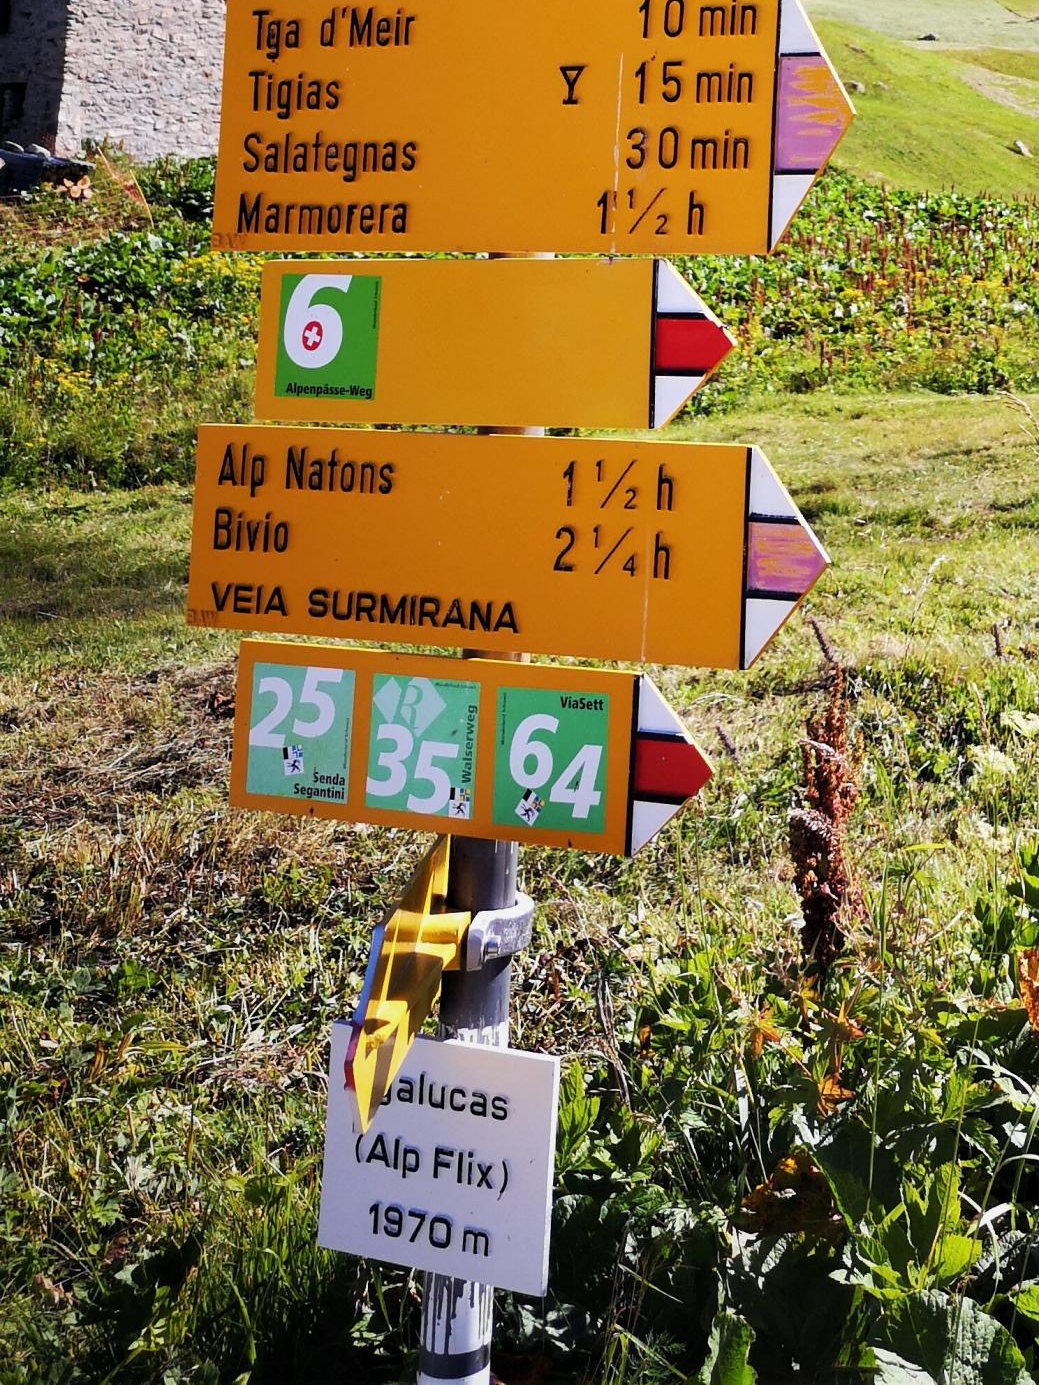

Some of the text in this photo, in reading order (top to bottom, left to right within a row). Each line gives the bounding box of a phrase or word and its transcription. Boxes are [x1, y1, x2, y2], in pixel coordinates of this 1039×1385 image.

[252, 10, 301, 60] Tga
[320, 6, 416, 47] d'Meir
[248, 61, 753, 120] Tigias 15 min
[243, 126, 749, 182] Salategnas 30 min
[237, 191, 408, 235] Marmorera
[687, 190, 705, 235] h
[283, 273, 353, 369] 6
[285, 382, 373, 400] Alpenpässe-Weg
[218, 443, 266, 498] Alp
[285, 446, 395, 495] Natons
[656, 463, 674, 511] h
[213, 507, 289, 553] Bivio
[653, 531, 671, 580] h
[211, 581, 520, 634] VEIA SURMIRANA
[248, 666, 344, 749] 25
[560, 696, 604, 711] ViaSett
[365, 723, 460, 814] 35
[462, 704, 478, 784] Walserweg
[509, 713, 603, 819] 64
[293, 783, 345, 800] Segantini
[313, 771, 346, 786] Senda
[355, 1133, 509, 1194] (Alp Flix)
[369, 1202, 491, 1257] 1970 m
